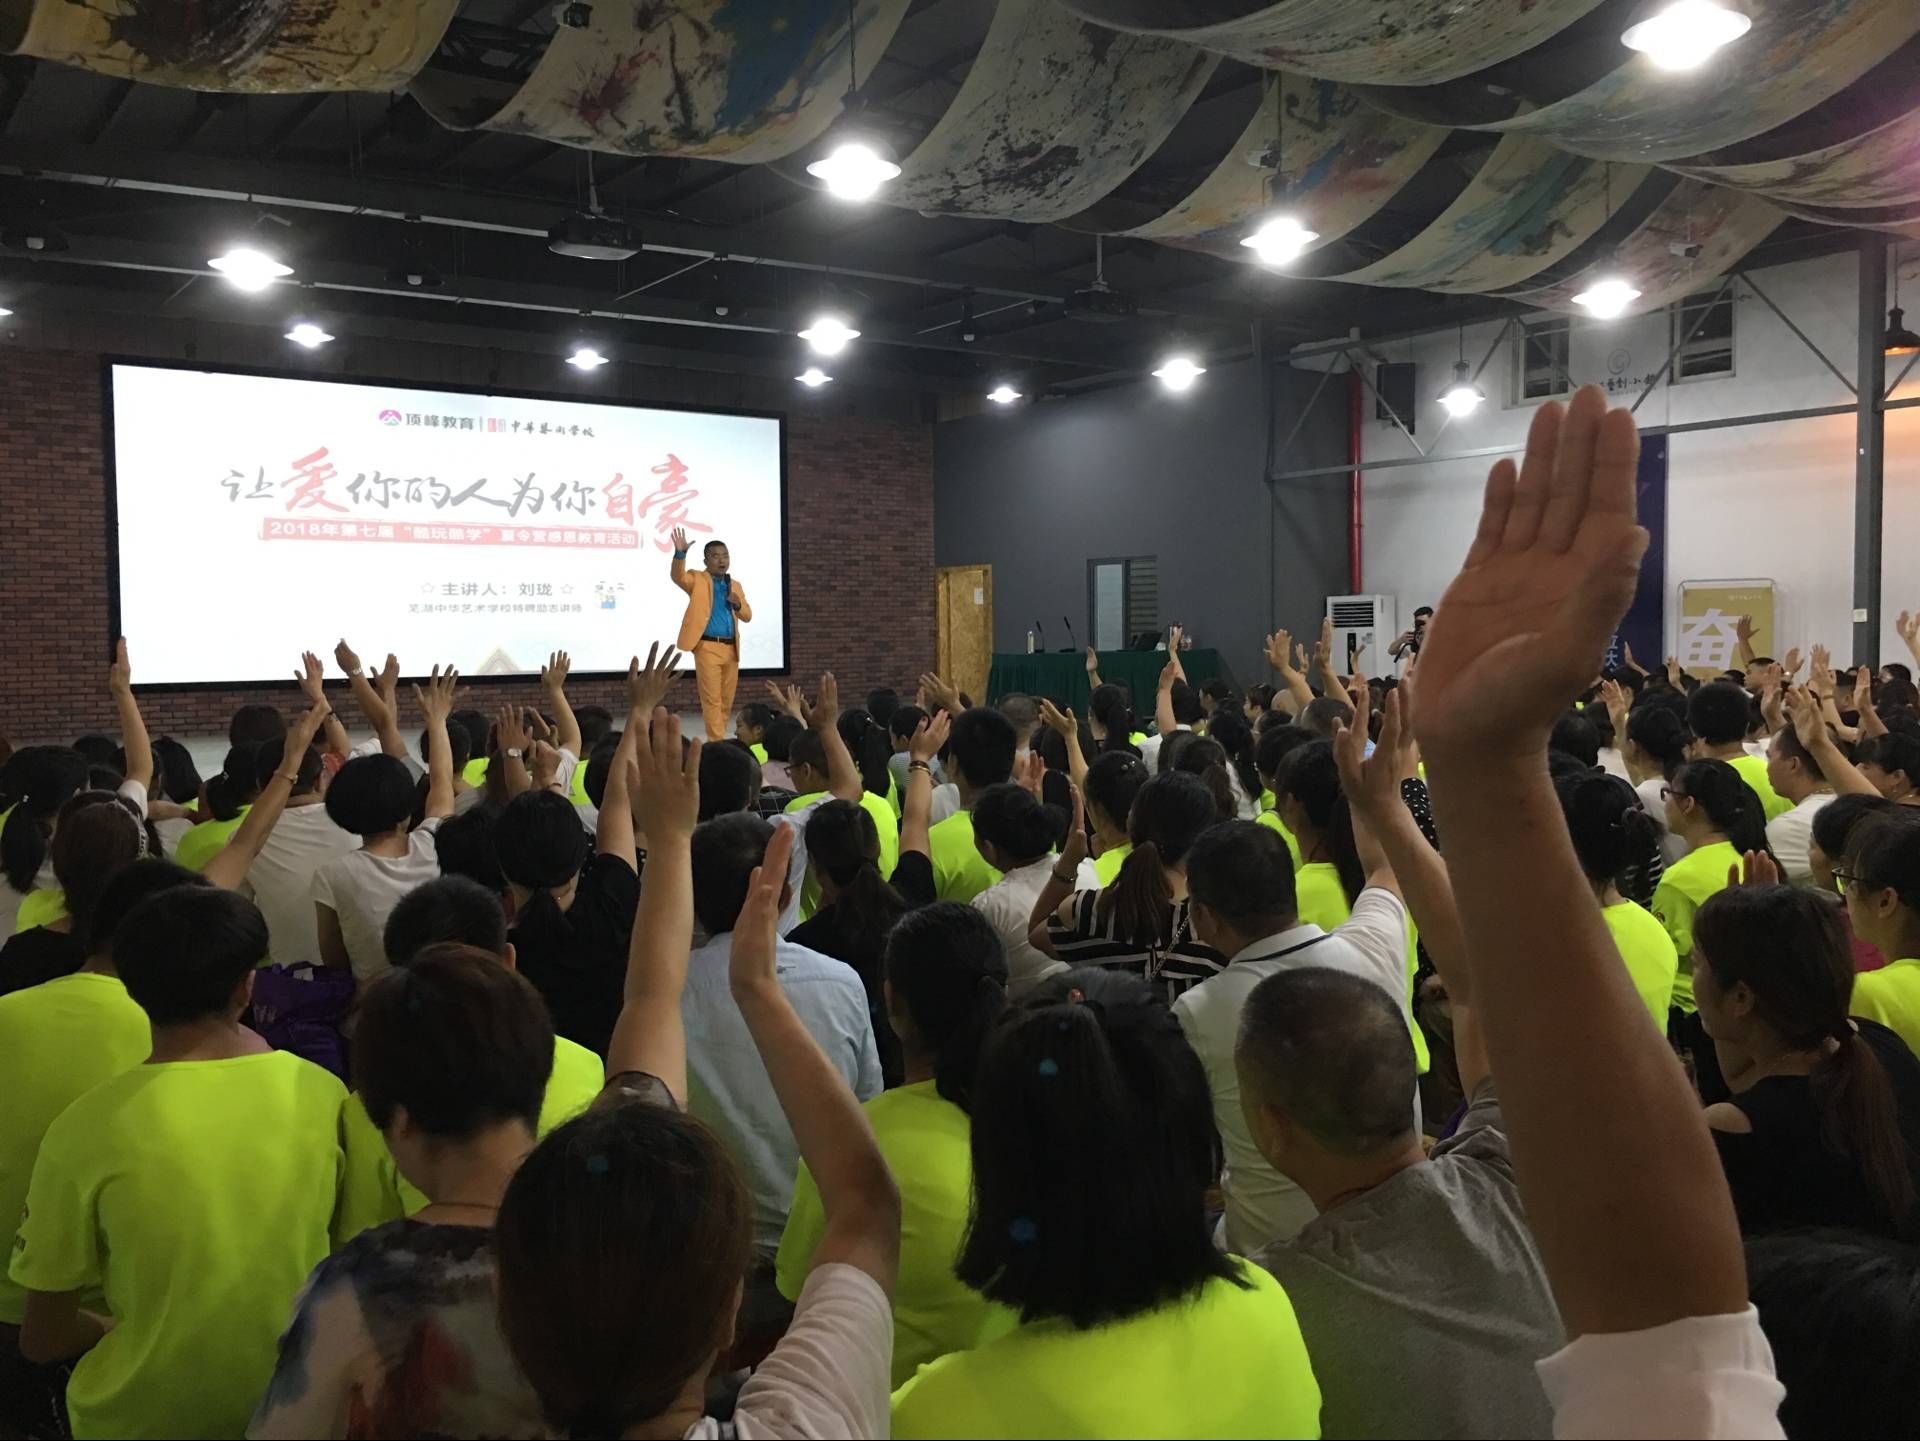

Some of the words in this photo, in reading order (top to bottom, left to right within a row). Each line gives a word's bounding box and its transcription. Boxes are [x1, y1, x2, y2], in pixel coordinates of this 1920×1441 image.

[405, 412, 475, 430] 顶峰教育
[221, 446, 714, 553] 让爱你的人为你自豪
